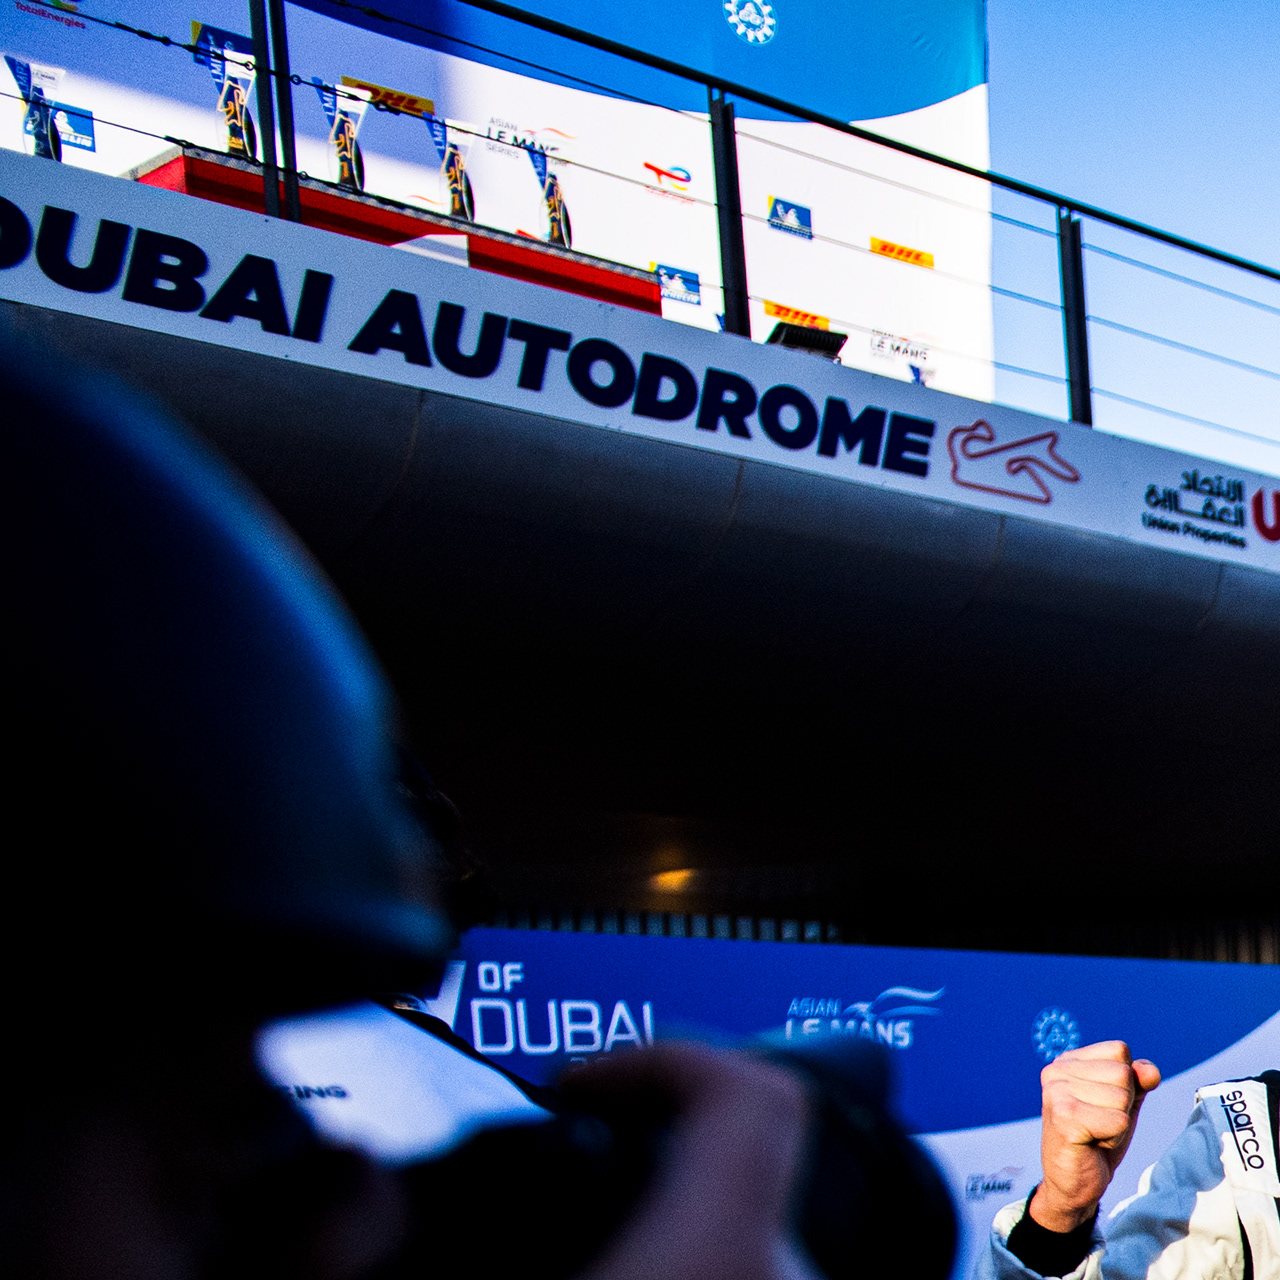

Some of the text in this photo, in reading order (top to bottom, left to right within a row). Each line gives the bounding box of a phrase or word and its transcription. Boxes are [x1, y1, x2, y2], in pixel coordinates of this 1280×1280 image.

[15, 2, 86, 30] TotalEnergies
[347, 289, 935, 478] AUTODROME
[477, 960, 524, 993] OF
[470, 998, 655, 1056] DUBAI
[1221, 1090, 1264, 1171] sparco
